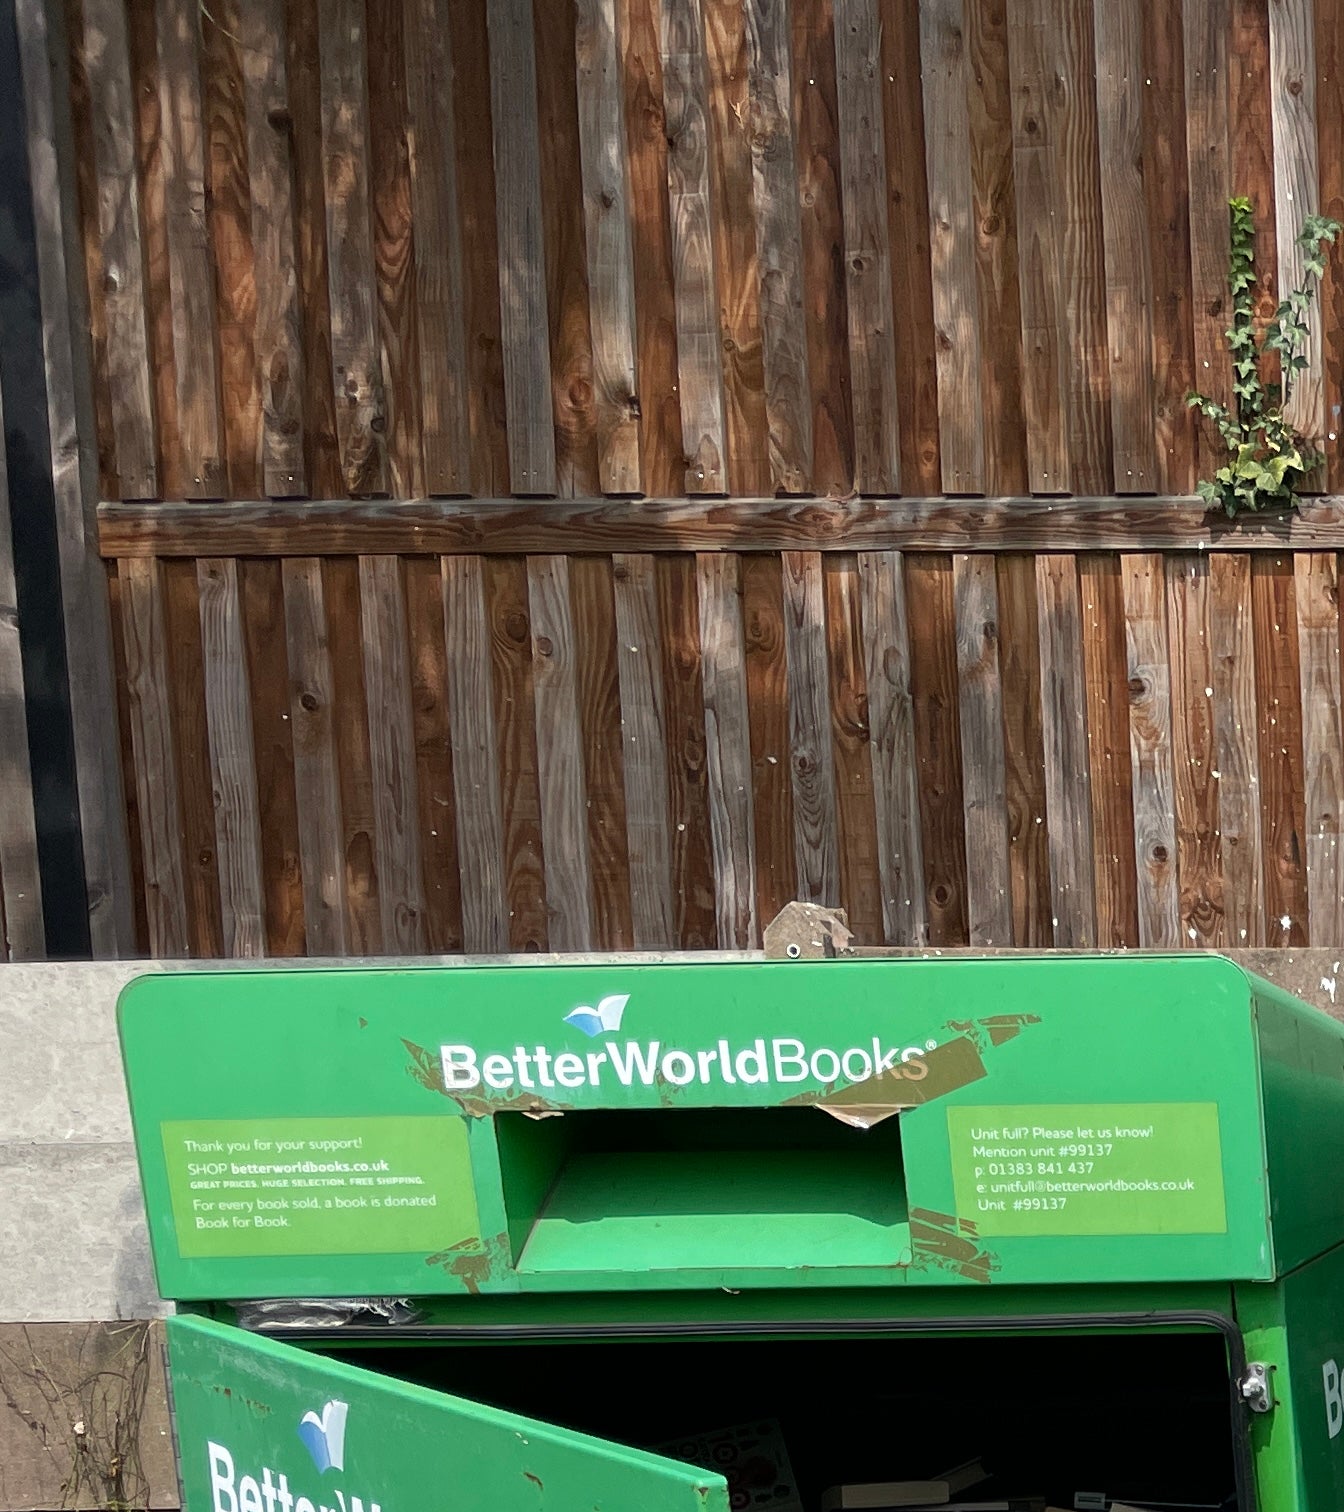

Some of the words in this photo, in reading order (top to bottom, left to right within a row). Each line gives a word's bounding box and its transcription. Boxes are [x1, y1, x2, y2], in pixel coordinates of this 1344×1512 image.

[971, 1128, 999, 1140] Unit
[1003, 1128, 1029, 1140] full?
[1033, 1127, 1074, 1139] Please
[1077, 1127, 1094, 1139] let
[1098, 1129, 1112, 1138] us
[1115, 1126, 1154, 1138] know!
[185, 1140, 224, 1152] Thank
[227, 1142, 250, 1154] you
[254, 1139, 273, 1151] for
[277, 1141, 305, 1153] your
[309, 1138, 363, 1151] support!
[973, 1146, 1027, 1158] Mention
[1030, 1145, 1055, 1157] unit
[1058, 1144, 1112, 1157] #99137
[188, 1163, 227, 1176] SHOP
[231, 1160, 389, 1175] betterworldbooks.co.uk
